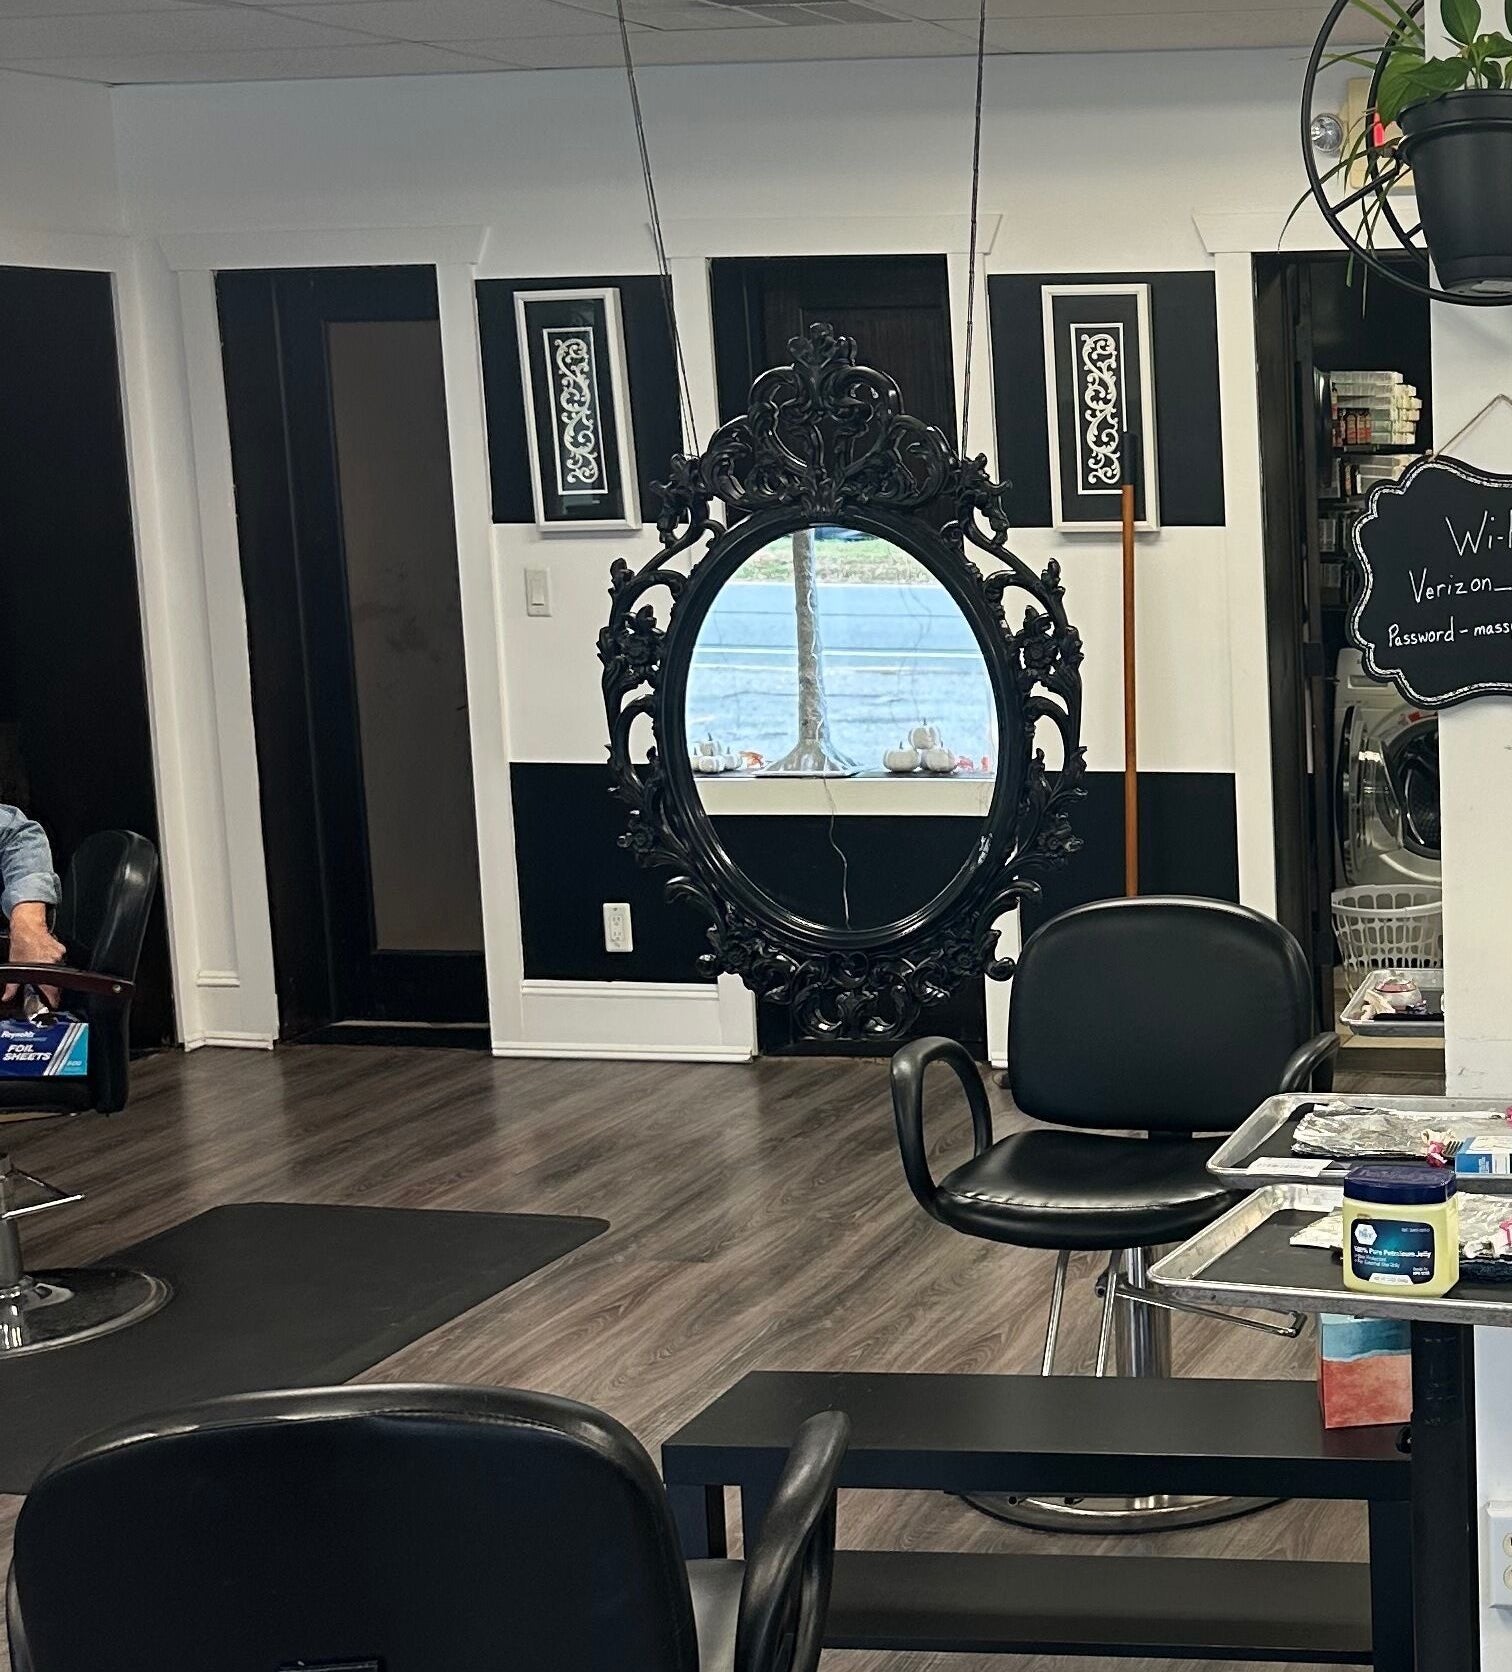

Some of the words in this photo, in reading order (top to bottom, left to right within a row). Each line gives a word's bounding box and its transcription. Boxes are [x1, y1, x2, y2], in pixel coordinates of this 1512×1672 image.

[1388, 615, 1456, 648] Password
[7, 1044, 34, 1053] FOIL
[3, 1052, 52, 1061] SHEETS
[1416, 1250, 1432, 1259] Jelly
